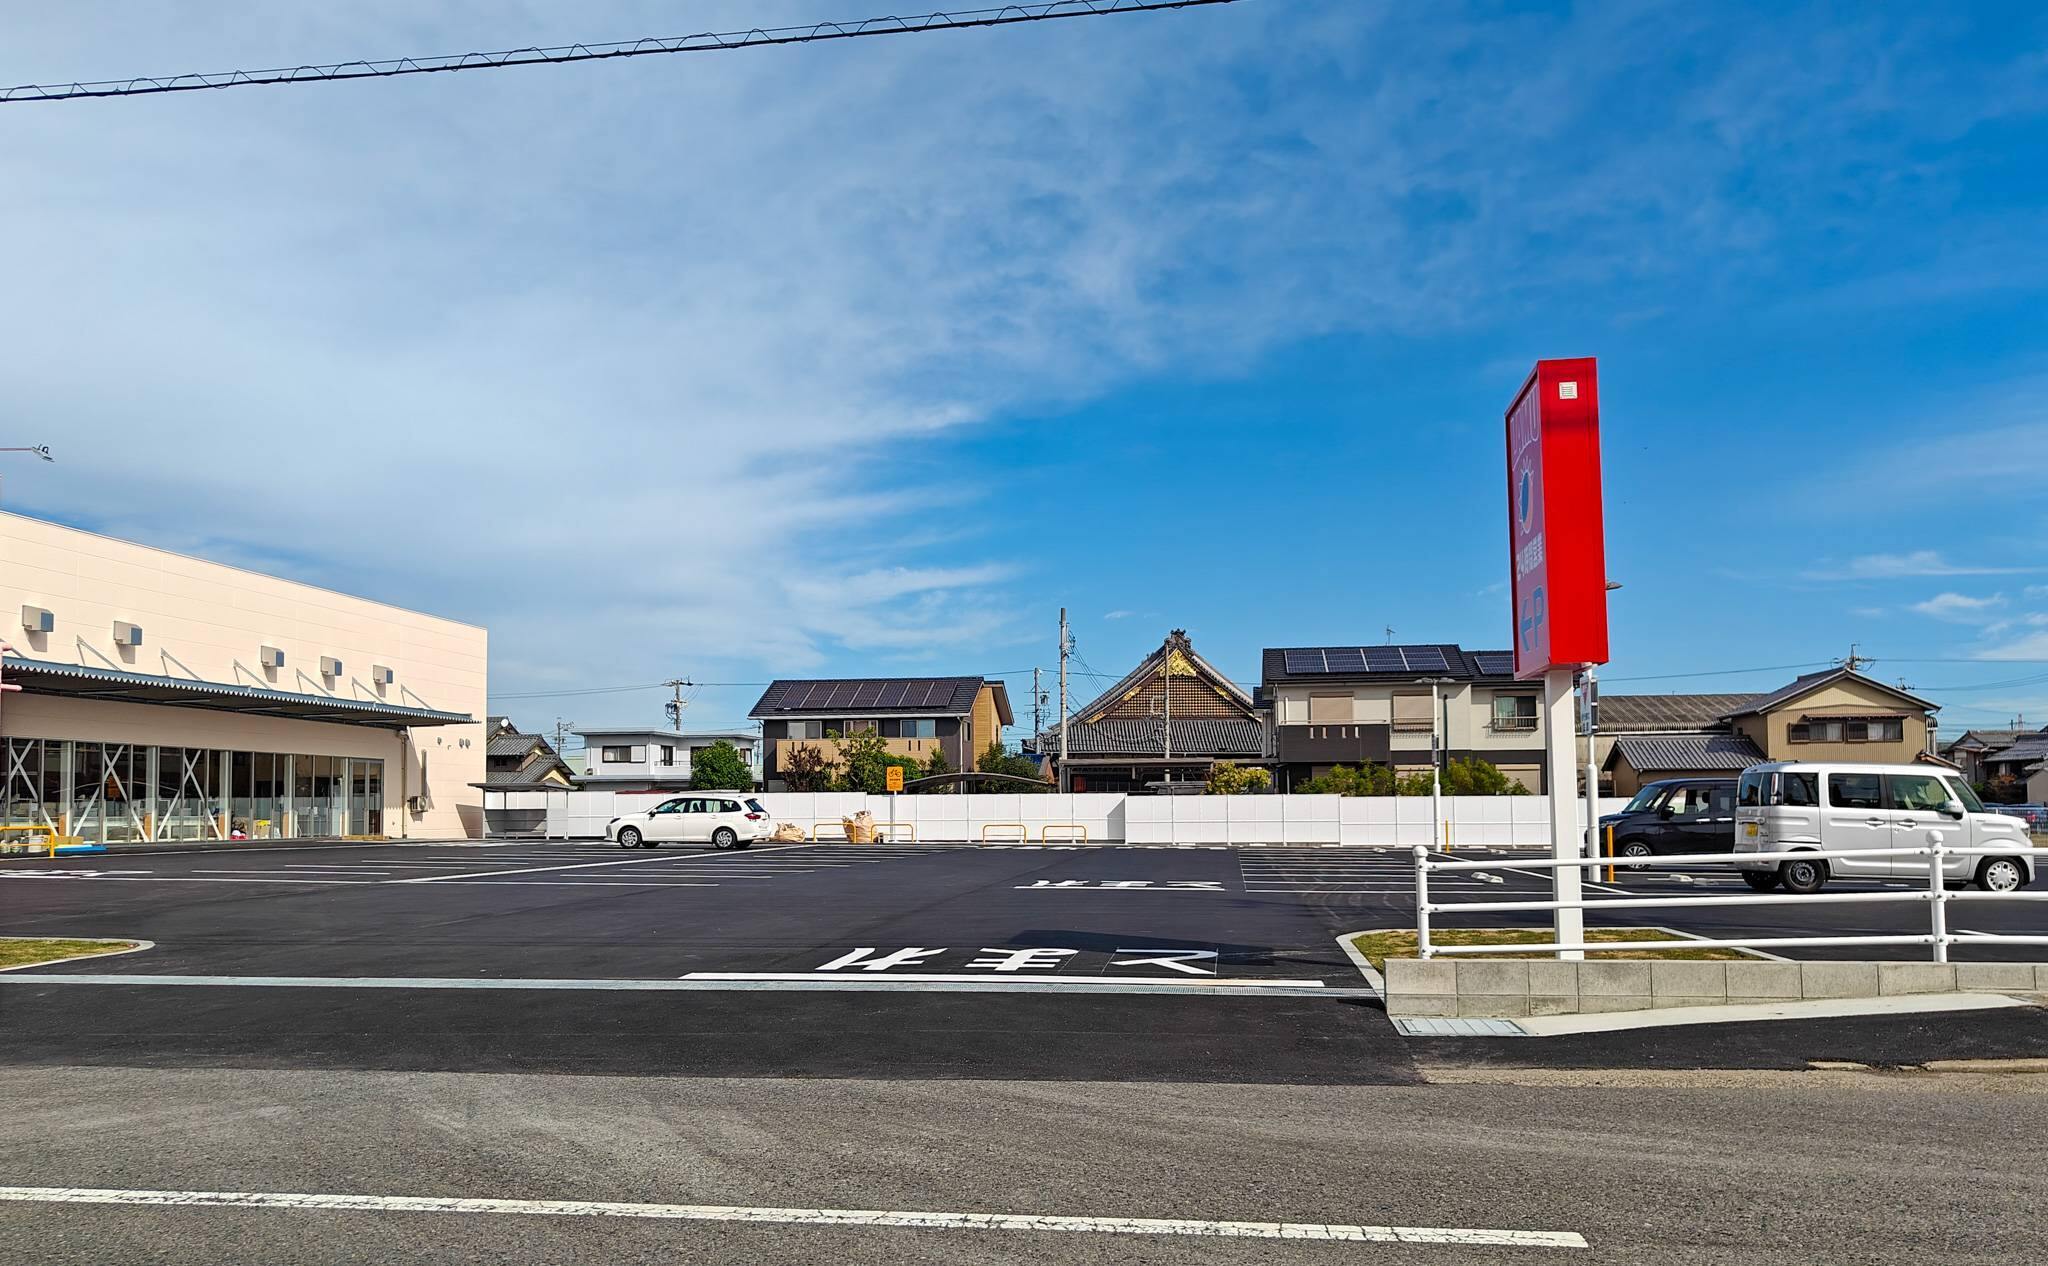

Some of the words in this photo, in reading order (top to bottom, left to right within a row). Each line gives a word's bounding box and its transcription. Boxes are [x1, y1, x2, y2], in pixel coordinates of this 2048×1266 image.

[1533, 586, 1544, 649] P
[815, 946, 1218, 975] とまれ
